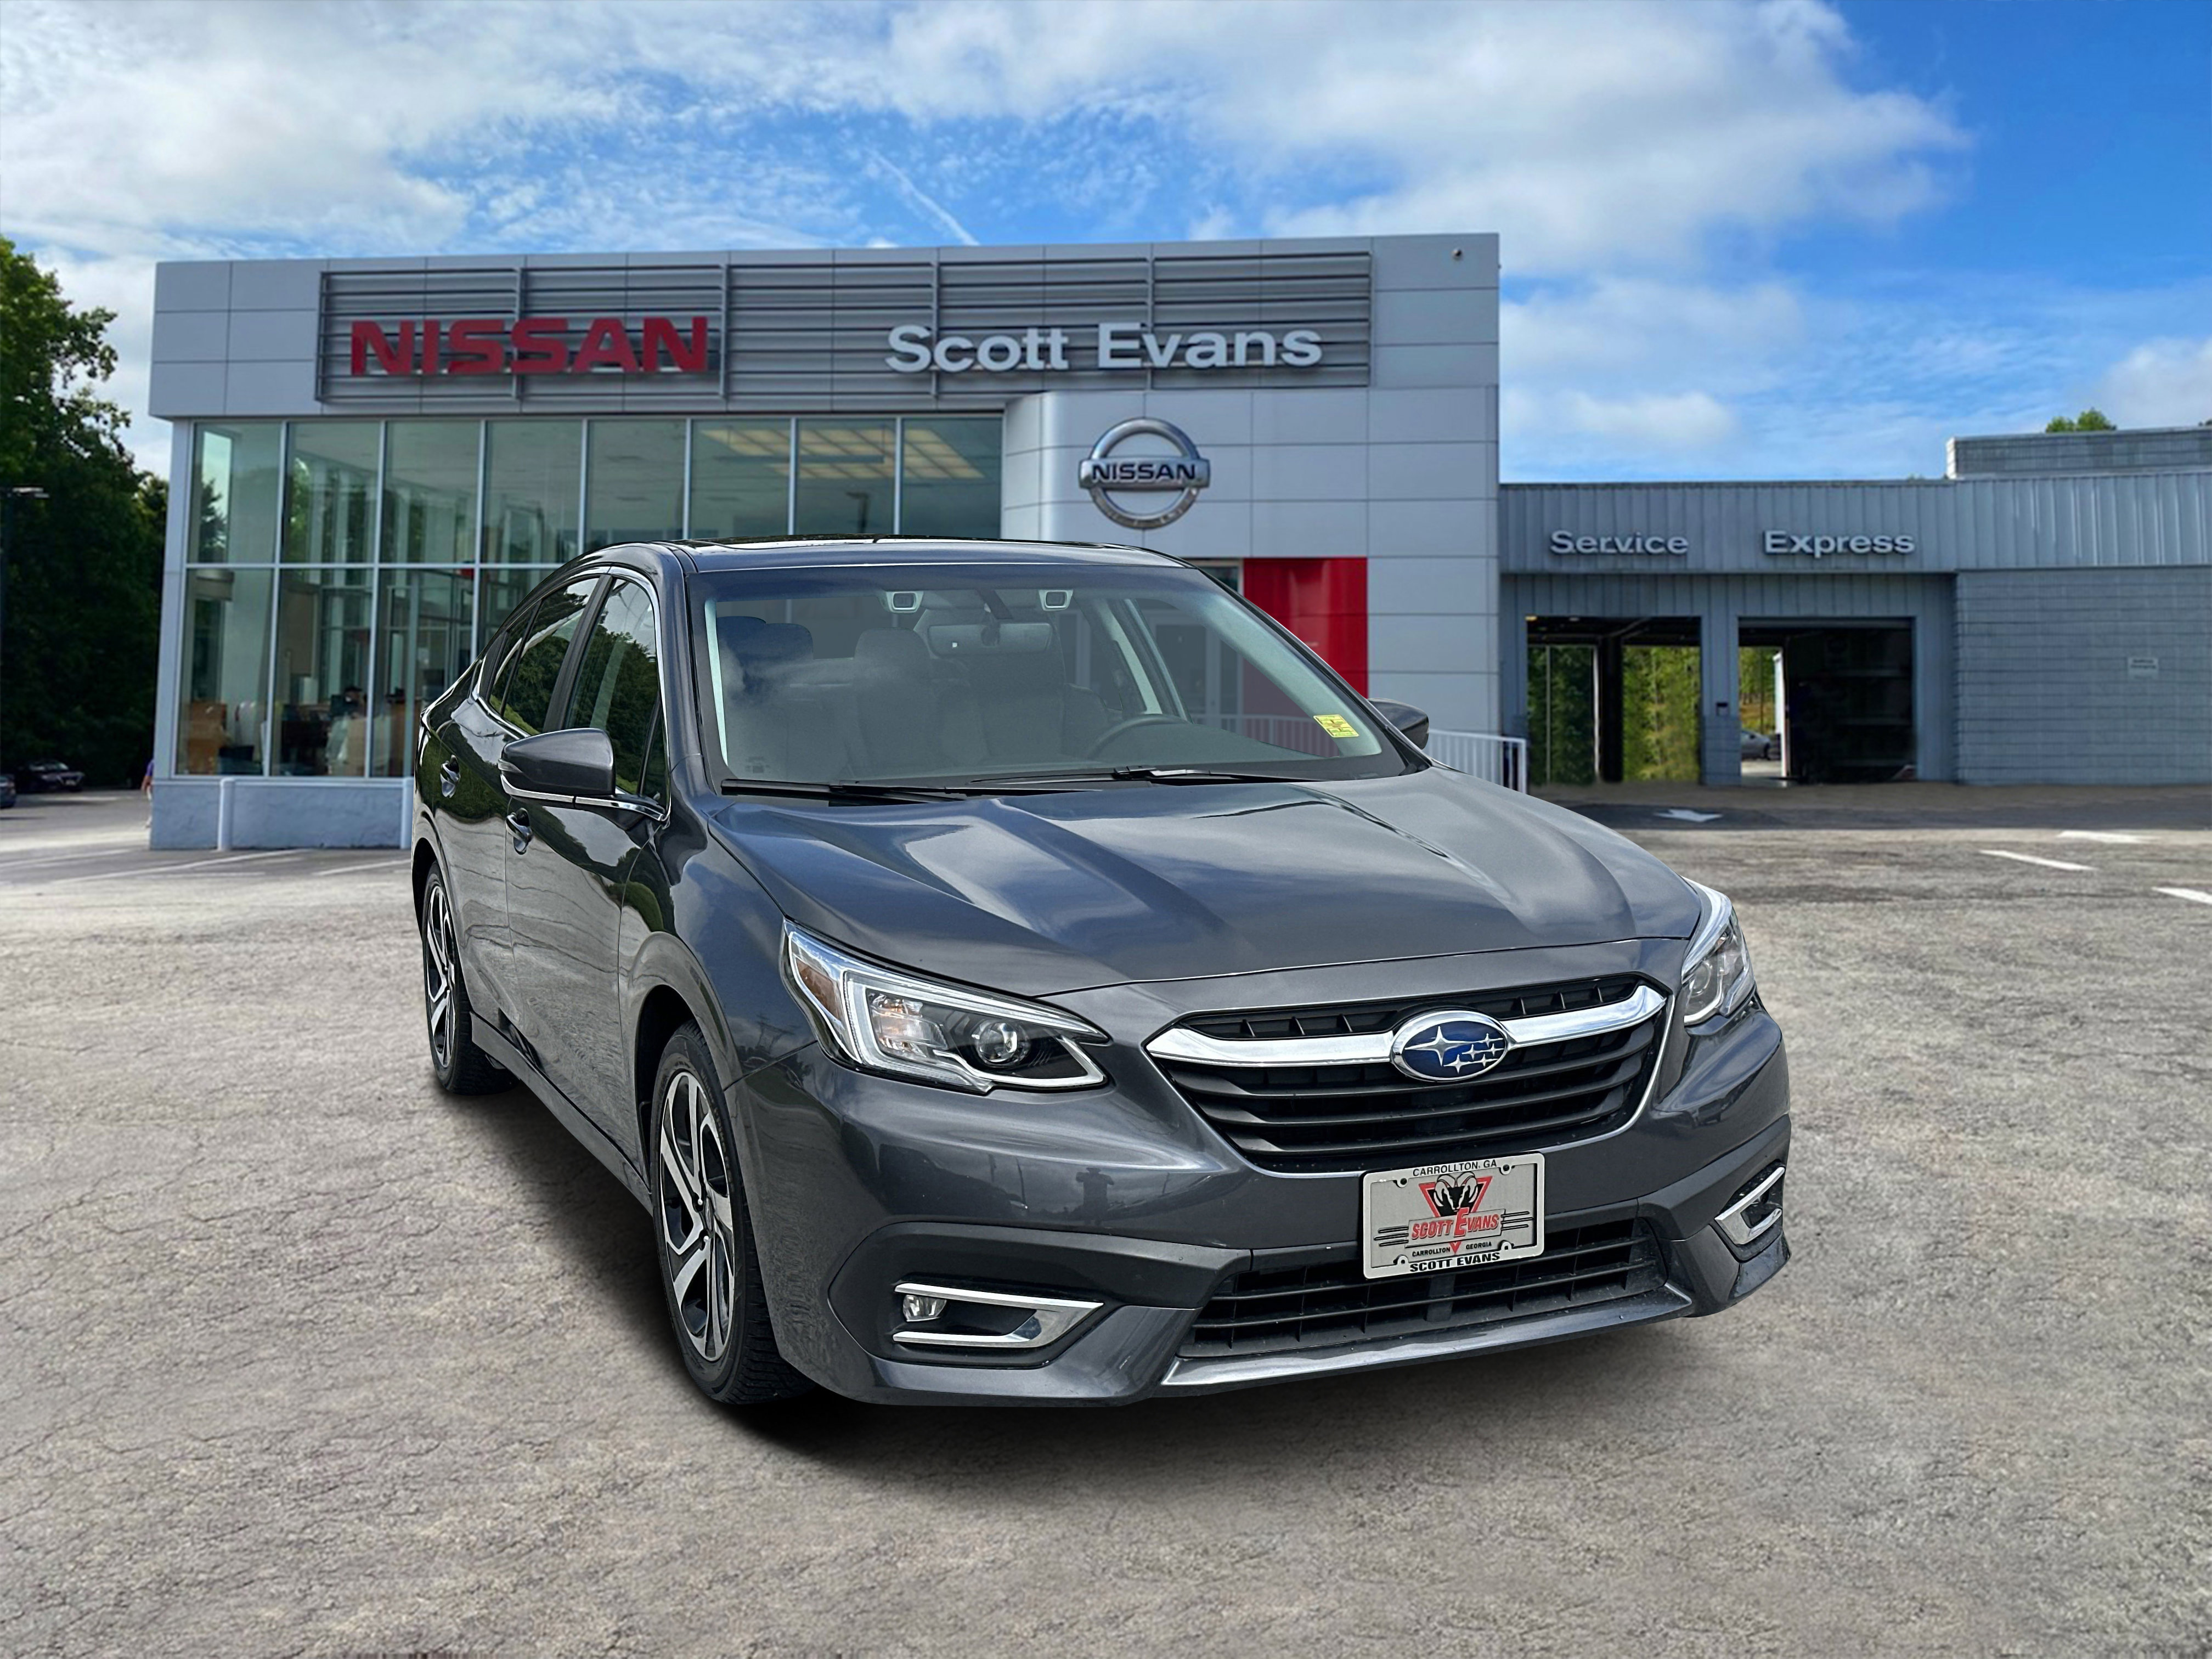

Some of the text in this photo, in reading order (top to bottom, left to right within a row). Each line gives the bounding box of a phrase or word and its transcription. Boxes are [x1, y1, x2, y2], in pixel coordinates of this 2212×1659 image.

[351, 317, 708, 376] NISSAN
[885, 322, 1323, 373] Scott Evans
[1092, 464, 1195, 479] NISSAN
[1550, 531, 1915, 557] Service Express
[1483, 1159, 1497, 1167] GA
[1412, 1207, 1499, 1239] SCOTT EVANS
[1410, 1252, 1500, 1272] SCOTT EVANS
[1412, 1248, 1451, 1257] CARROLLTON
